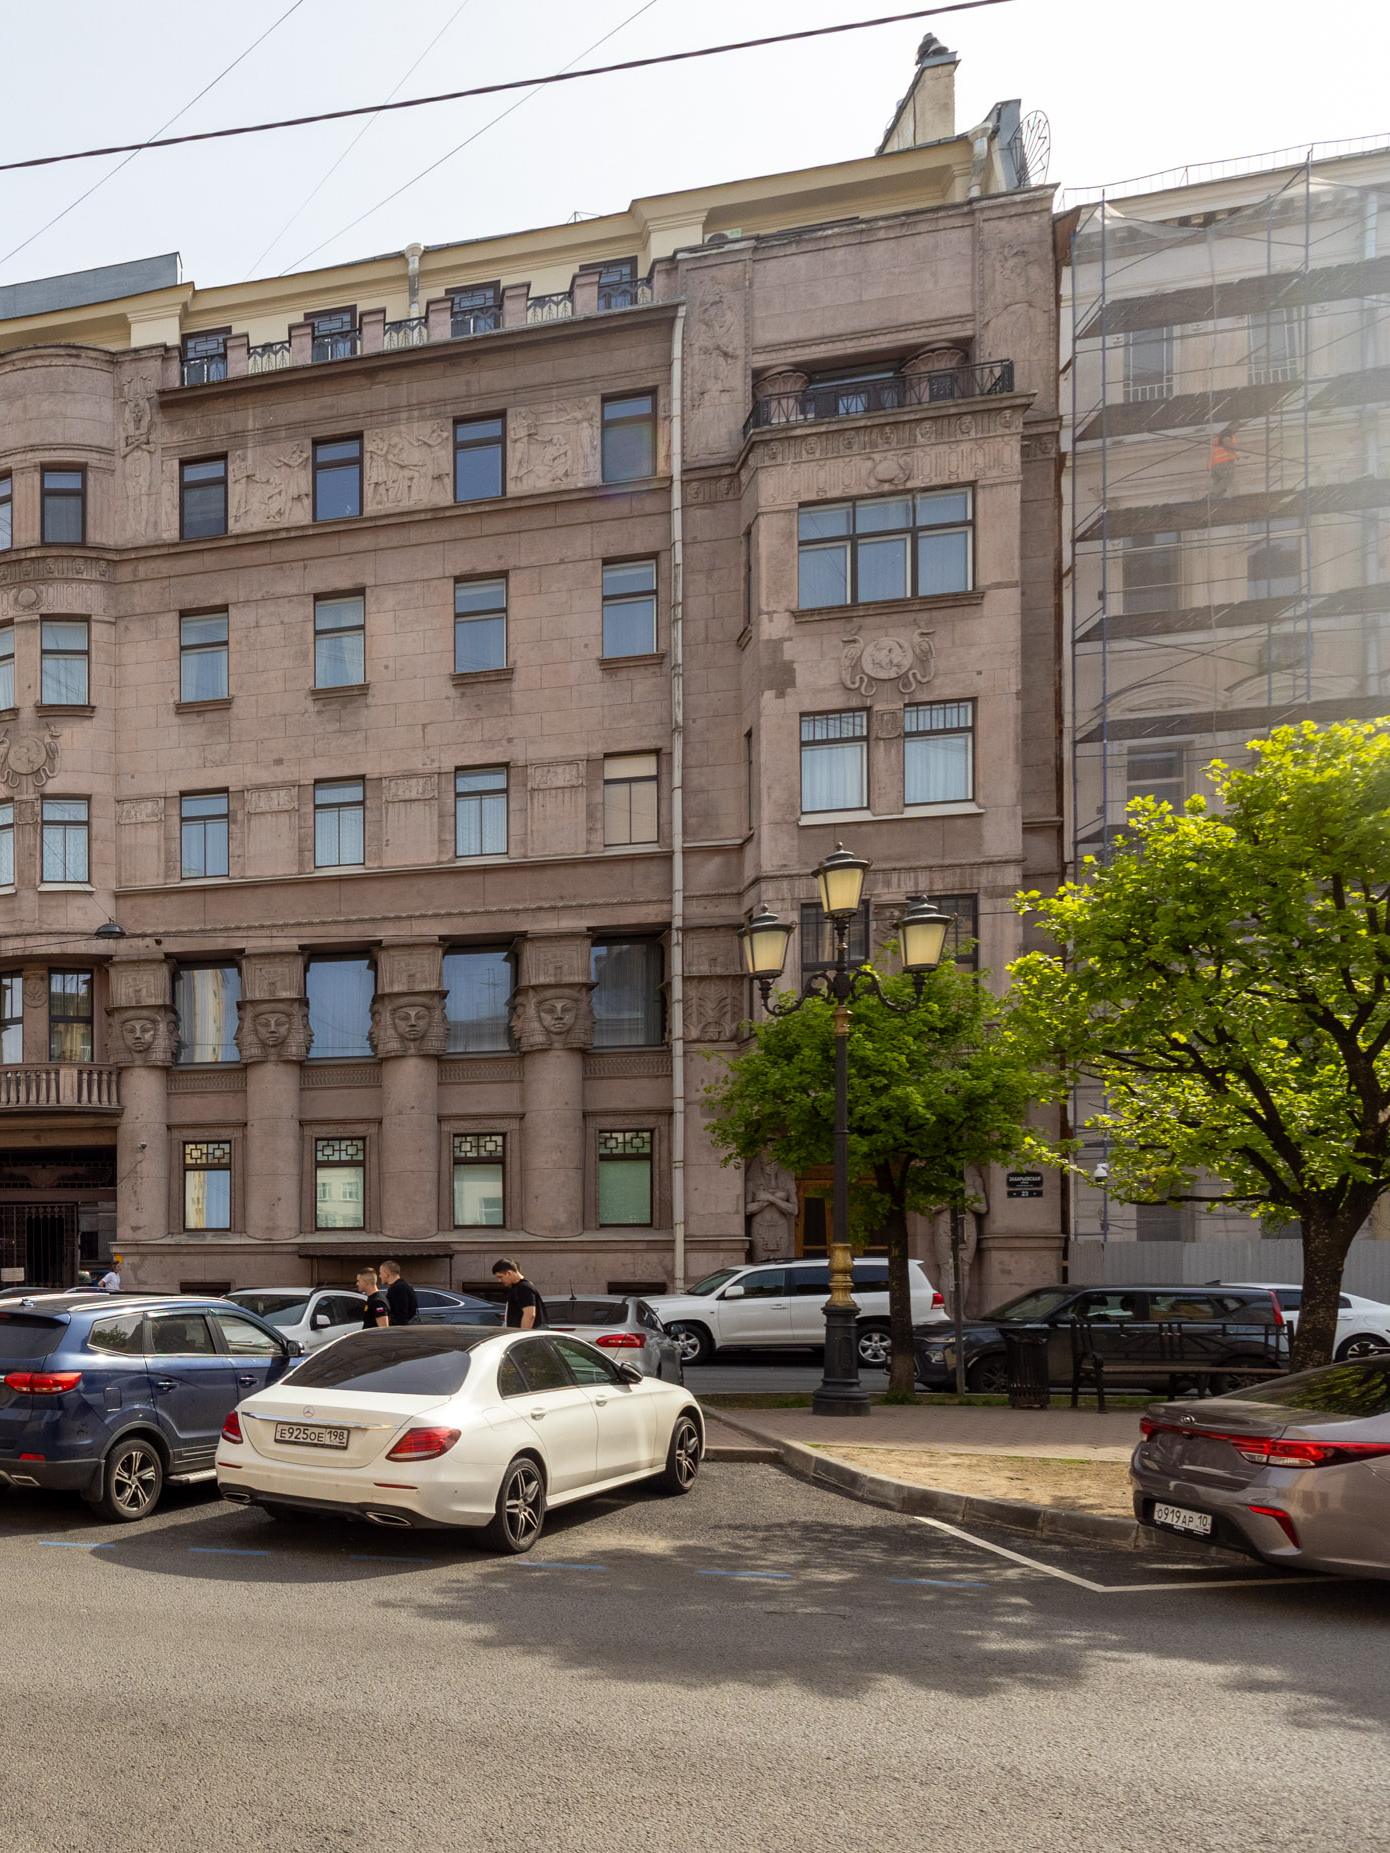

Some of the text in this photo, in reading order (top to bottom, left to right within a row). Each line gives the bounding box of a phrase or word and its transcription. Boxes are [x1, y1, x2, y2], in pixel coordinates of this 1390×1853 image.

[280, 1427, 345, 1442] Е925ОЕ 198
[1157, 1507, 1208, 1527] О919АР 10
